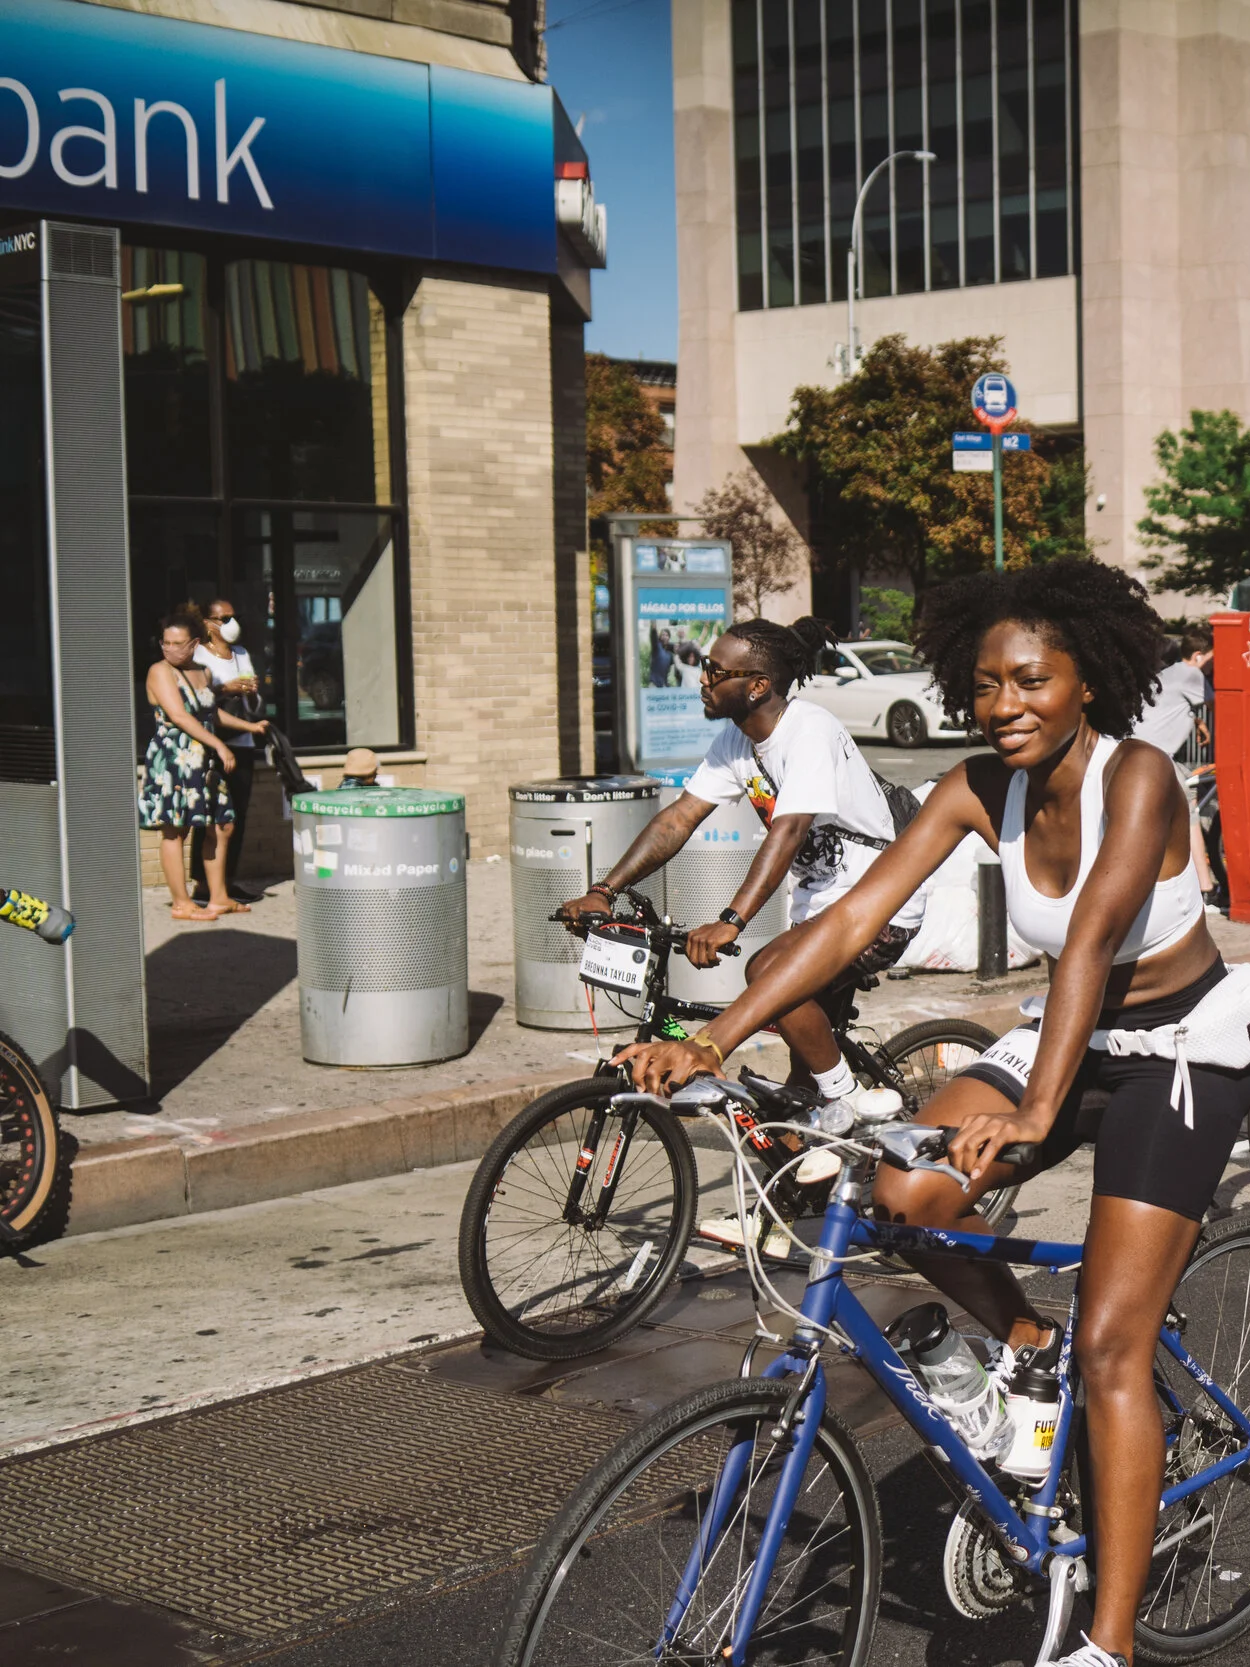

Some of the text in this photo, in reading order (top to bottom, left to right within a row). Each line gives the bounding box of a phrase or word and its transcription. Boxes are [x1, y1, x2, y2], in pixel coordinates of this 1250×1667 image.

[1002, 435, 1019, 448] M2
[640, 601, 725, 613] HÁGALO POR ELLOS
[656, 703, 688, 712] COVID-19
[515, 791, 556, 802] Don't litter
[583, 790, 635, 802] Don't litter
[312, 802, 363, 816] Recycle
[396, 802, 447, 815] Recycle
[526, 846, 554, 859] place
[344, 863, 440, 877] Mixed Paper
[584, 959, 637, 985] BREONNA TAYLOR
